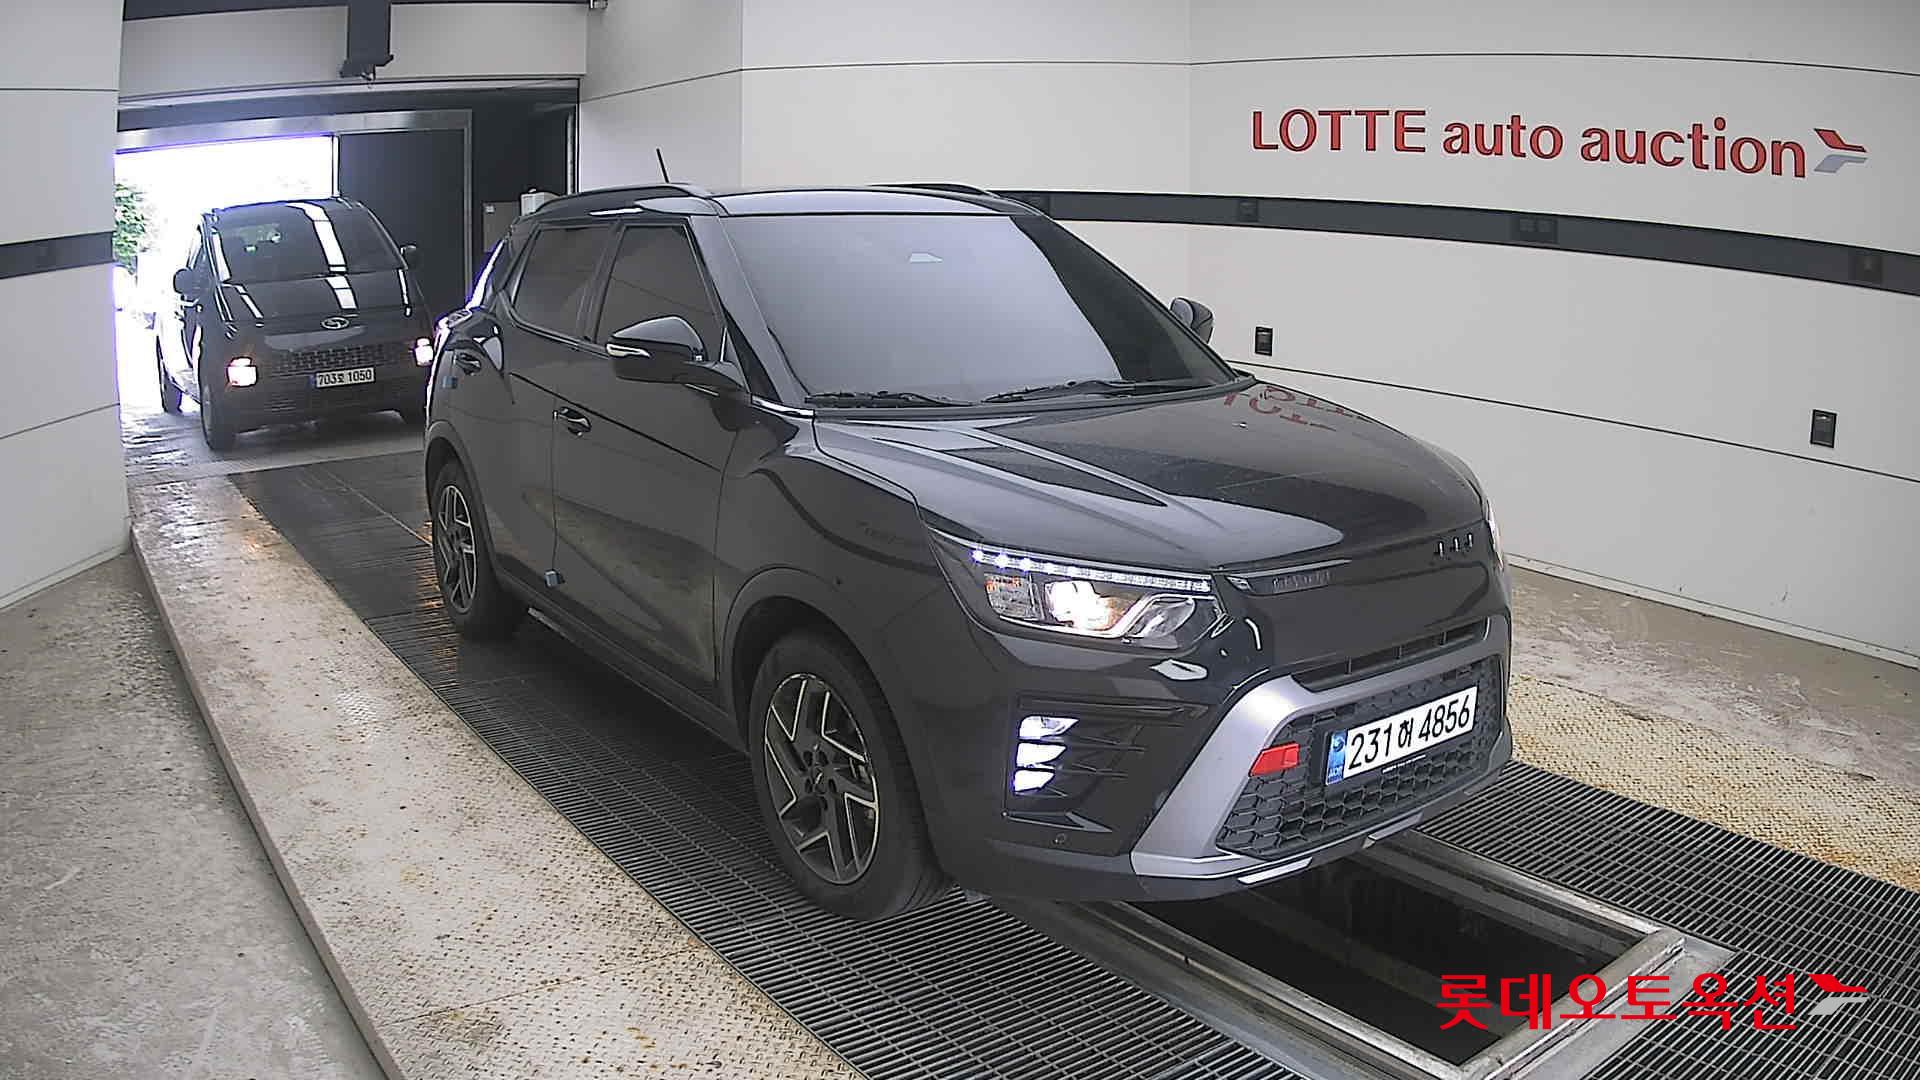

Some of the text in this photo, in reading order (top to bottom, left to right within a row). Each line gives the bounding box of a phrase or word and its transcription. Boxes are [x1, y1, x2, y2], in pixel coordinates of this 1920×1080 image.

[1252, 108, 1807, 178] LOTTE auto auction
[1348, 694, 1471, 770] 231허 4856
